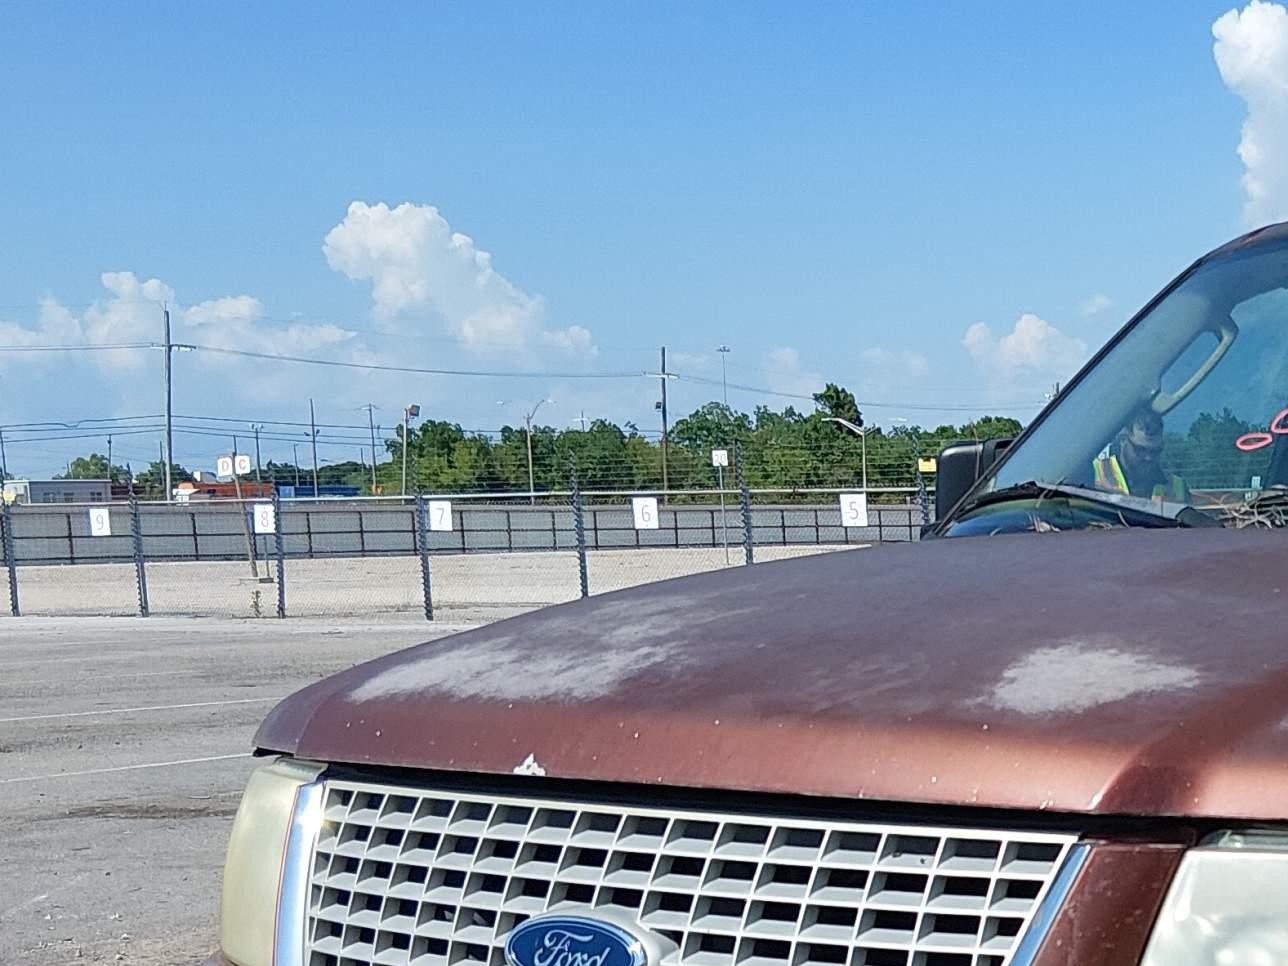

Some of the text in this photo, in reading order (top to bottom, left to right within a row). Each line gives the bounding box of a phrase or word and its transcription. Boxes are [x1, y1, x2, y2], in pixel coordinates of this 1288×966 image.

[221, 460, 230, 472] D
[238, 458, 247, 470] C
[260, 511, 269, 528] 8
[436, 507, 446, 525] 7
[641, 504, 651, 524] 6
[847, 500, 860, 523] 5
[95, 513, 104, 531] 9
